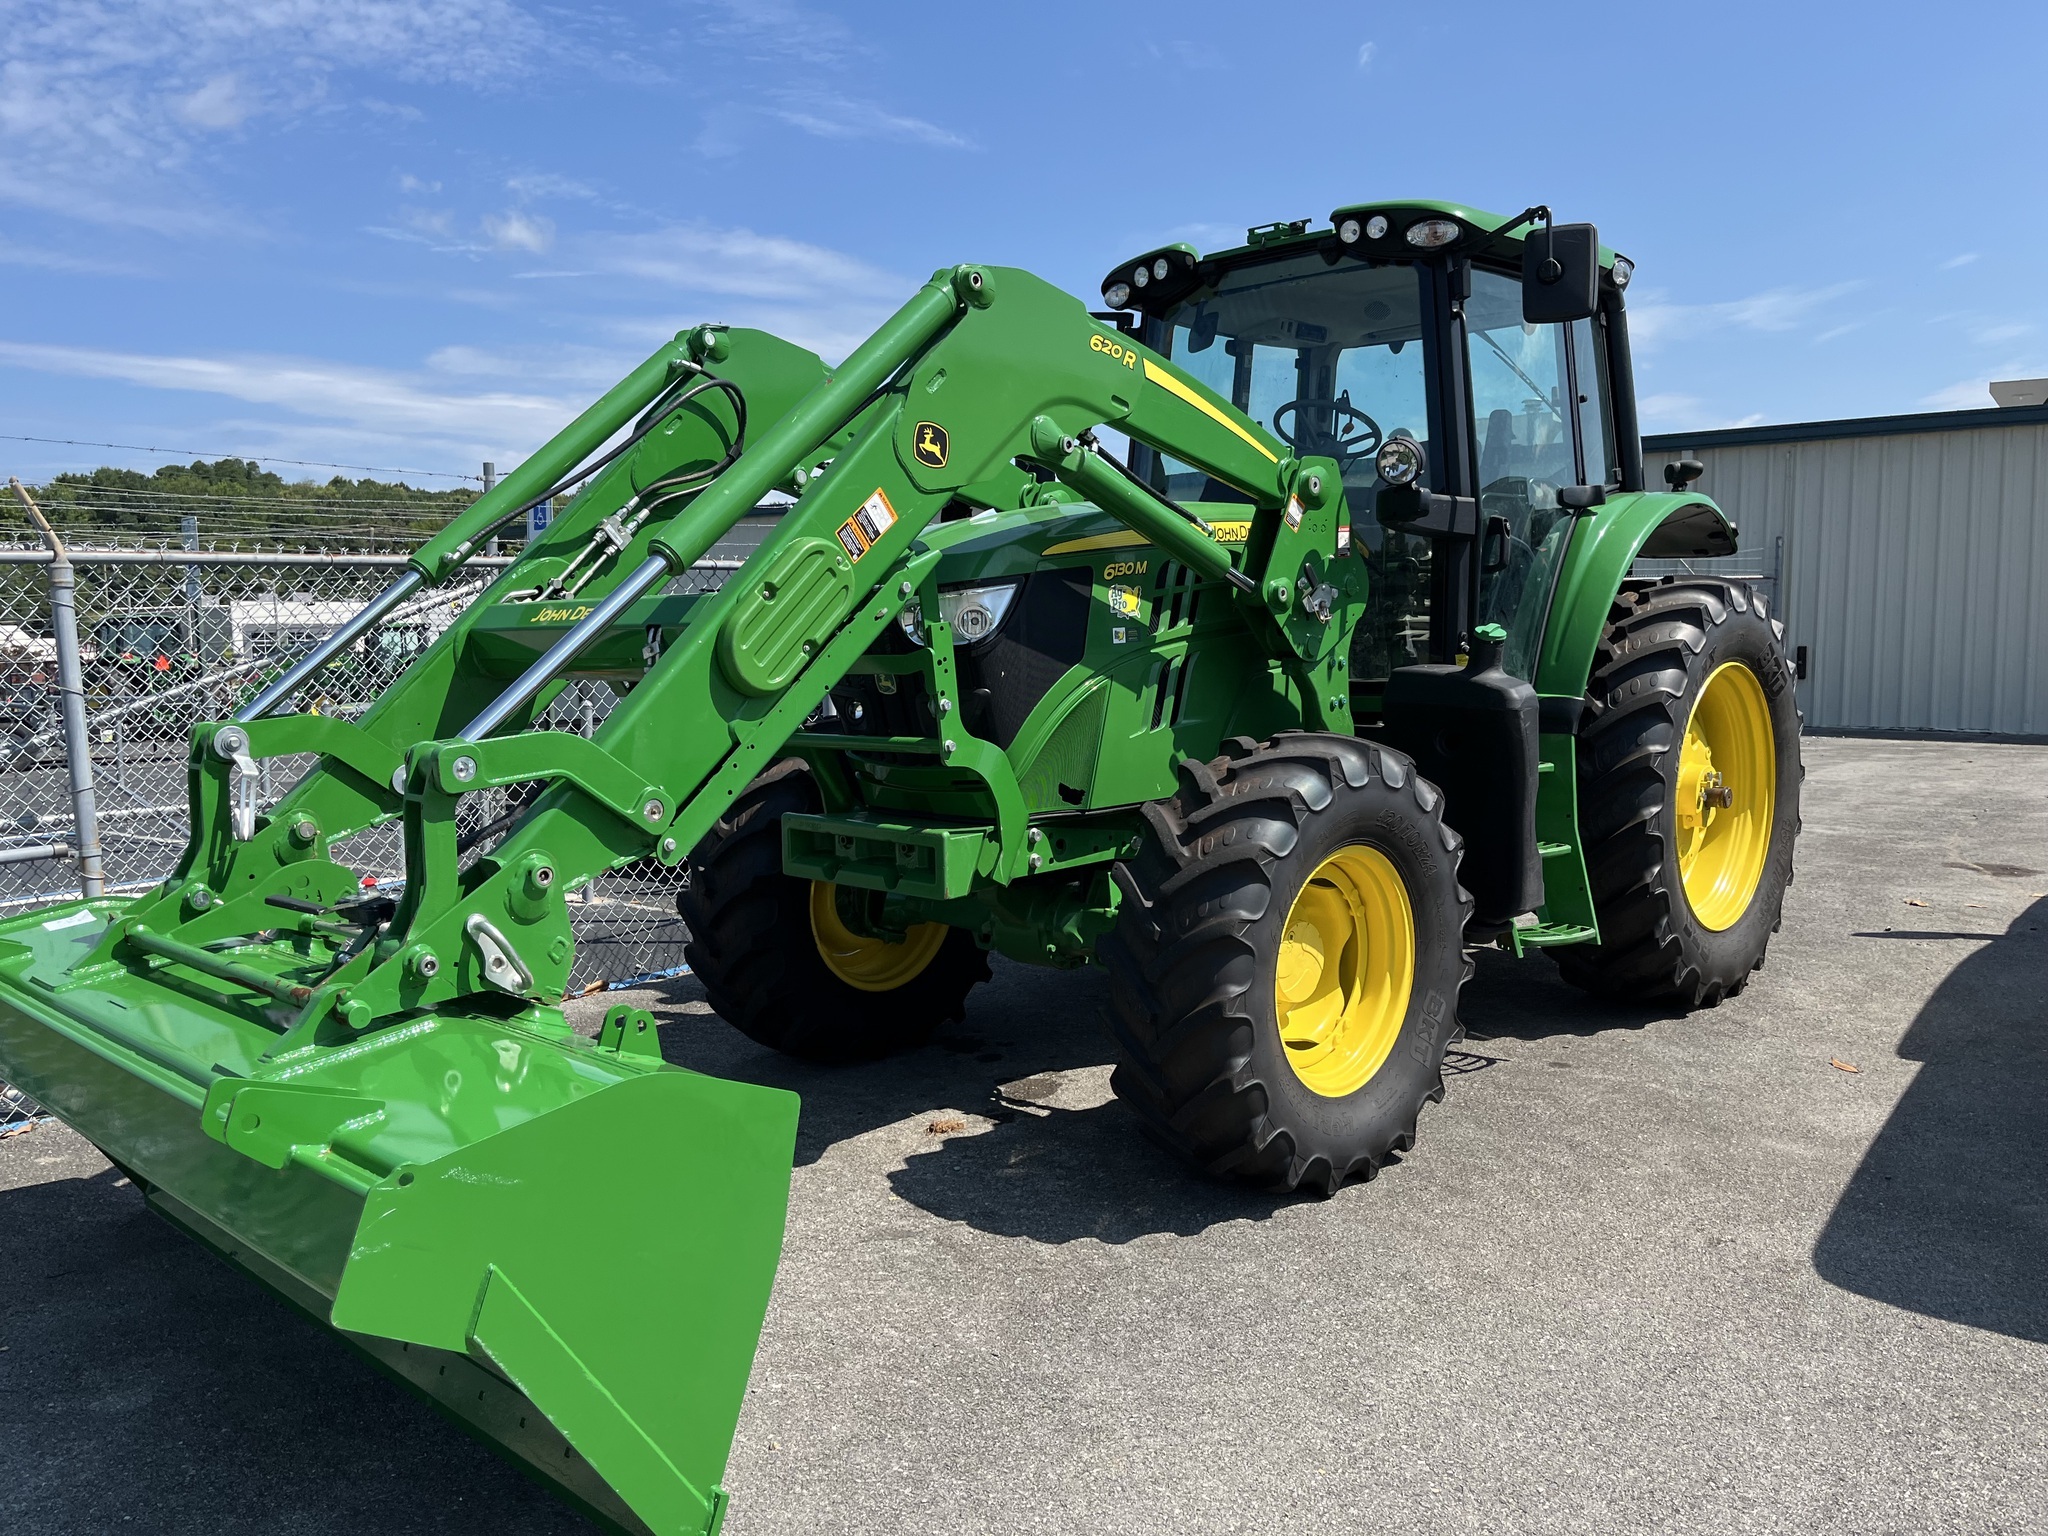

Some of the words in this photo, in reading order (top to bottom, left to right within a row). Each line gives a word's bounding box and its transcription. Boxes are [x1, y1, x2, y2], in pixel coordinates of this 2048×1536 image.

[1089, 334, 1123, 359] 620
[1122, 349, 1137, 370] R
[1214, 526, 1239, 539] JOHN
[1103, 562, 1134, 580] 6130
[1135, 560, 1148, 575] M
[1111, 588, 1123, 600] Ag
[1112, 599, 1127, 610] Pro
[530, 607, 573, 621] JOHN
[1757, 642, 1787, 699] BKT
[1411, 990, 1446, 1067] BKT
